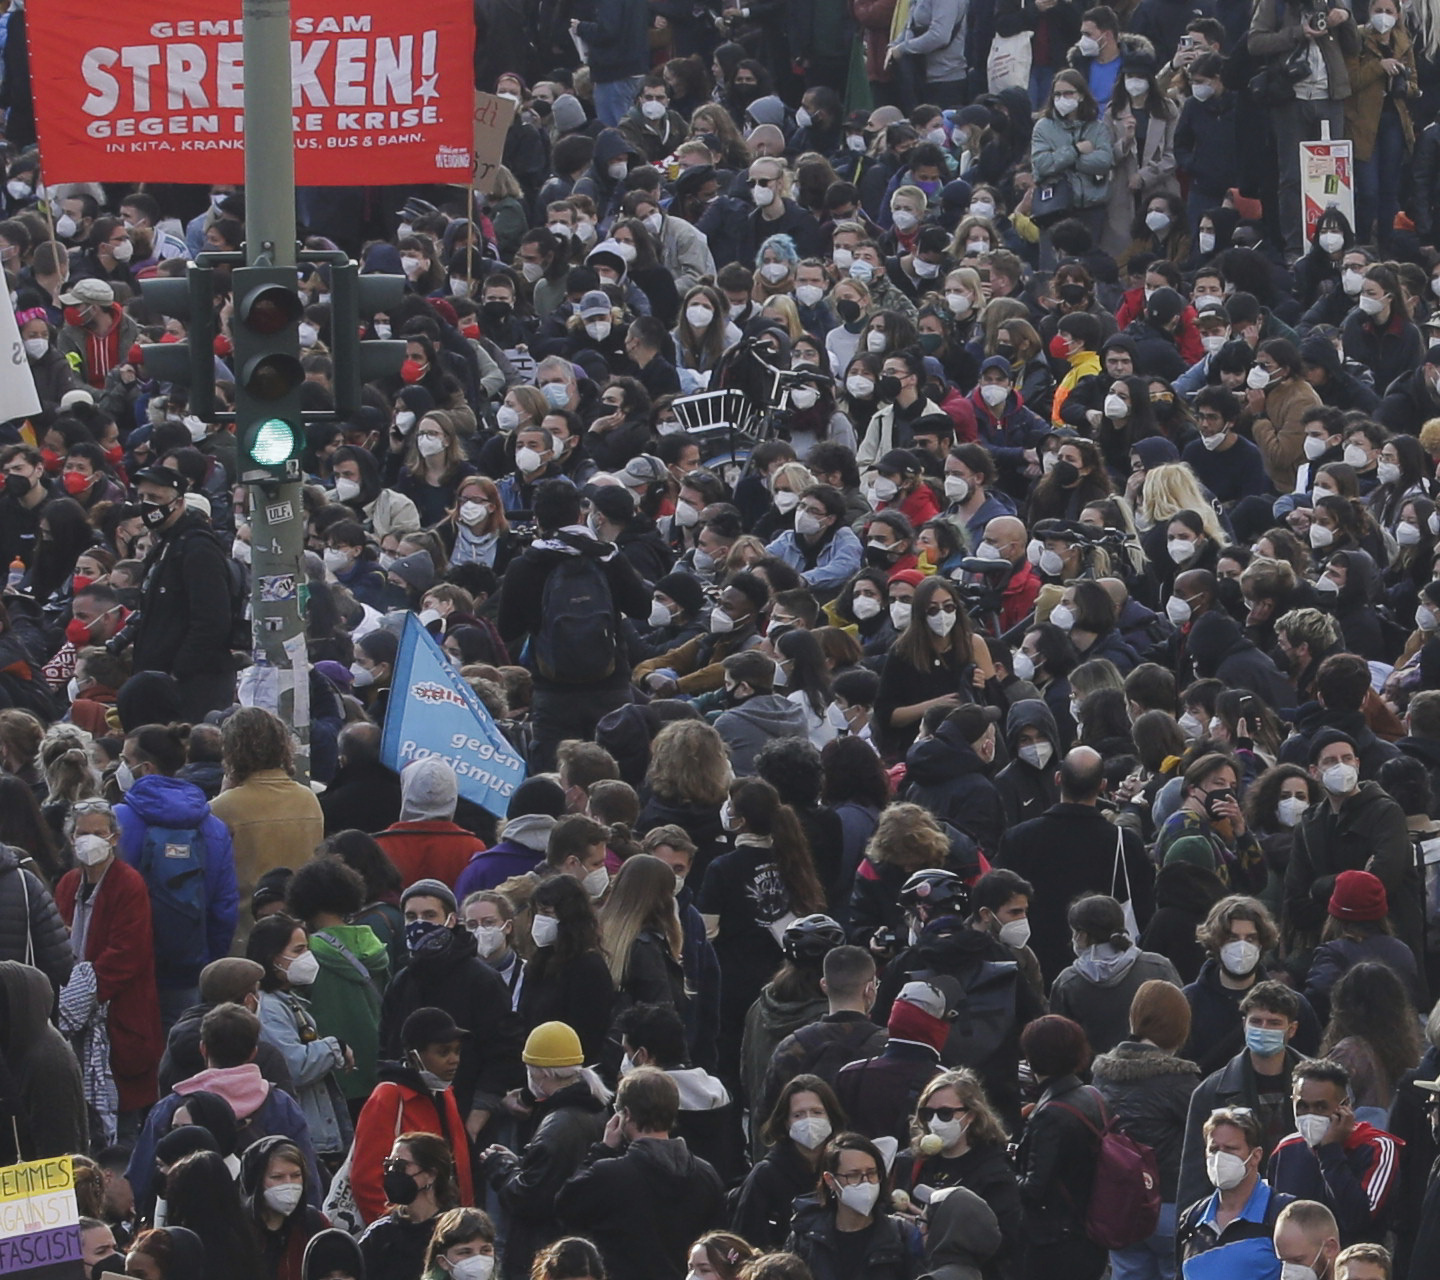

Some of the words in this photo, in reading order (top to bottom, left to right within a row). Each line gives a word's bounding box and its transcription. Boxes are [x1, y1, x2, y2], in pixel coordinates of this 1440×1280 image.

[150, 14, 372, 39] GEMSAM
[80, 28, 440, 117] STREKEN!
[86, 114, 220, 139] GEGEN
[337, 107, 444, 130] KRISE.
[106, 143, 125, 153] IN
[130, 141, 177, 153] KITA,
[181, 136, 323, 152] KRANKAUS,
[327, 136, 359, 148] BUS
[378, 133, 426, 146] BAHN.
[450, 732, 521, 772] gegen
